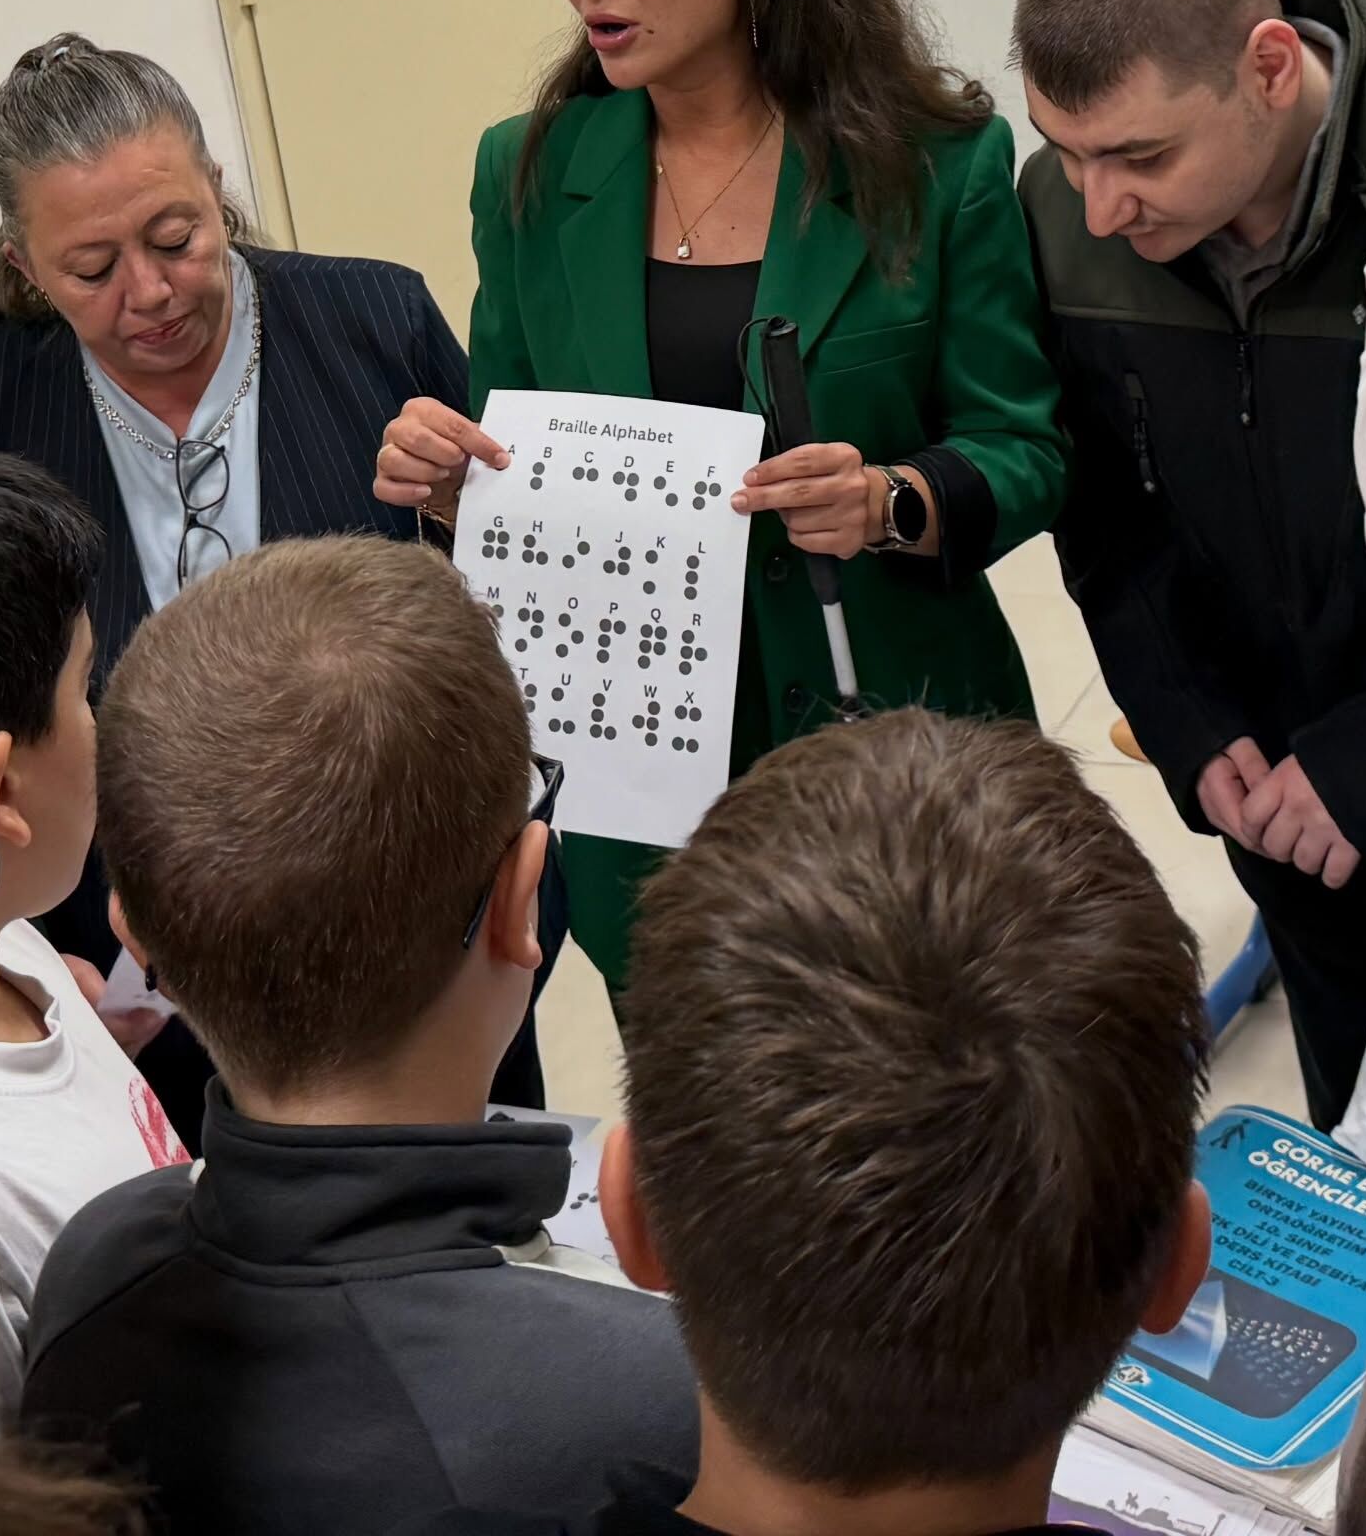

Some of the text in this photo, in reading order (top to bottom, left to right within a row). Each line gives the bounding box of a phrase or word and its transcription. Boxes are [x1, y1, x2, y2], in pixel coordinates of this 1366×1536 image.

[548, 418, 674, 444] Braille Alphabet
[507, 444, 716, 478] A B C D E F
[493, 516, 707, 554] G H I J K L
[486, 586, 702, 626] M N O P Q R
[519, 667, 695, 704] T U V W X
[1272, 1138, 1357, 1185] GÖRME
[1215, 1235, 1322, 1287] DERS KİTABI
[1233, 1226, 1271, 1247] DİLİ
[1271, 1242, 1295, 1259] VE
[1284, 1233, 1334, 1256] SINIF
